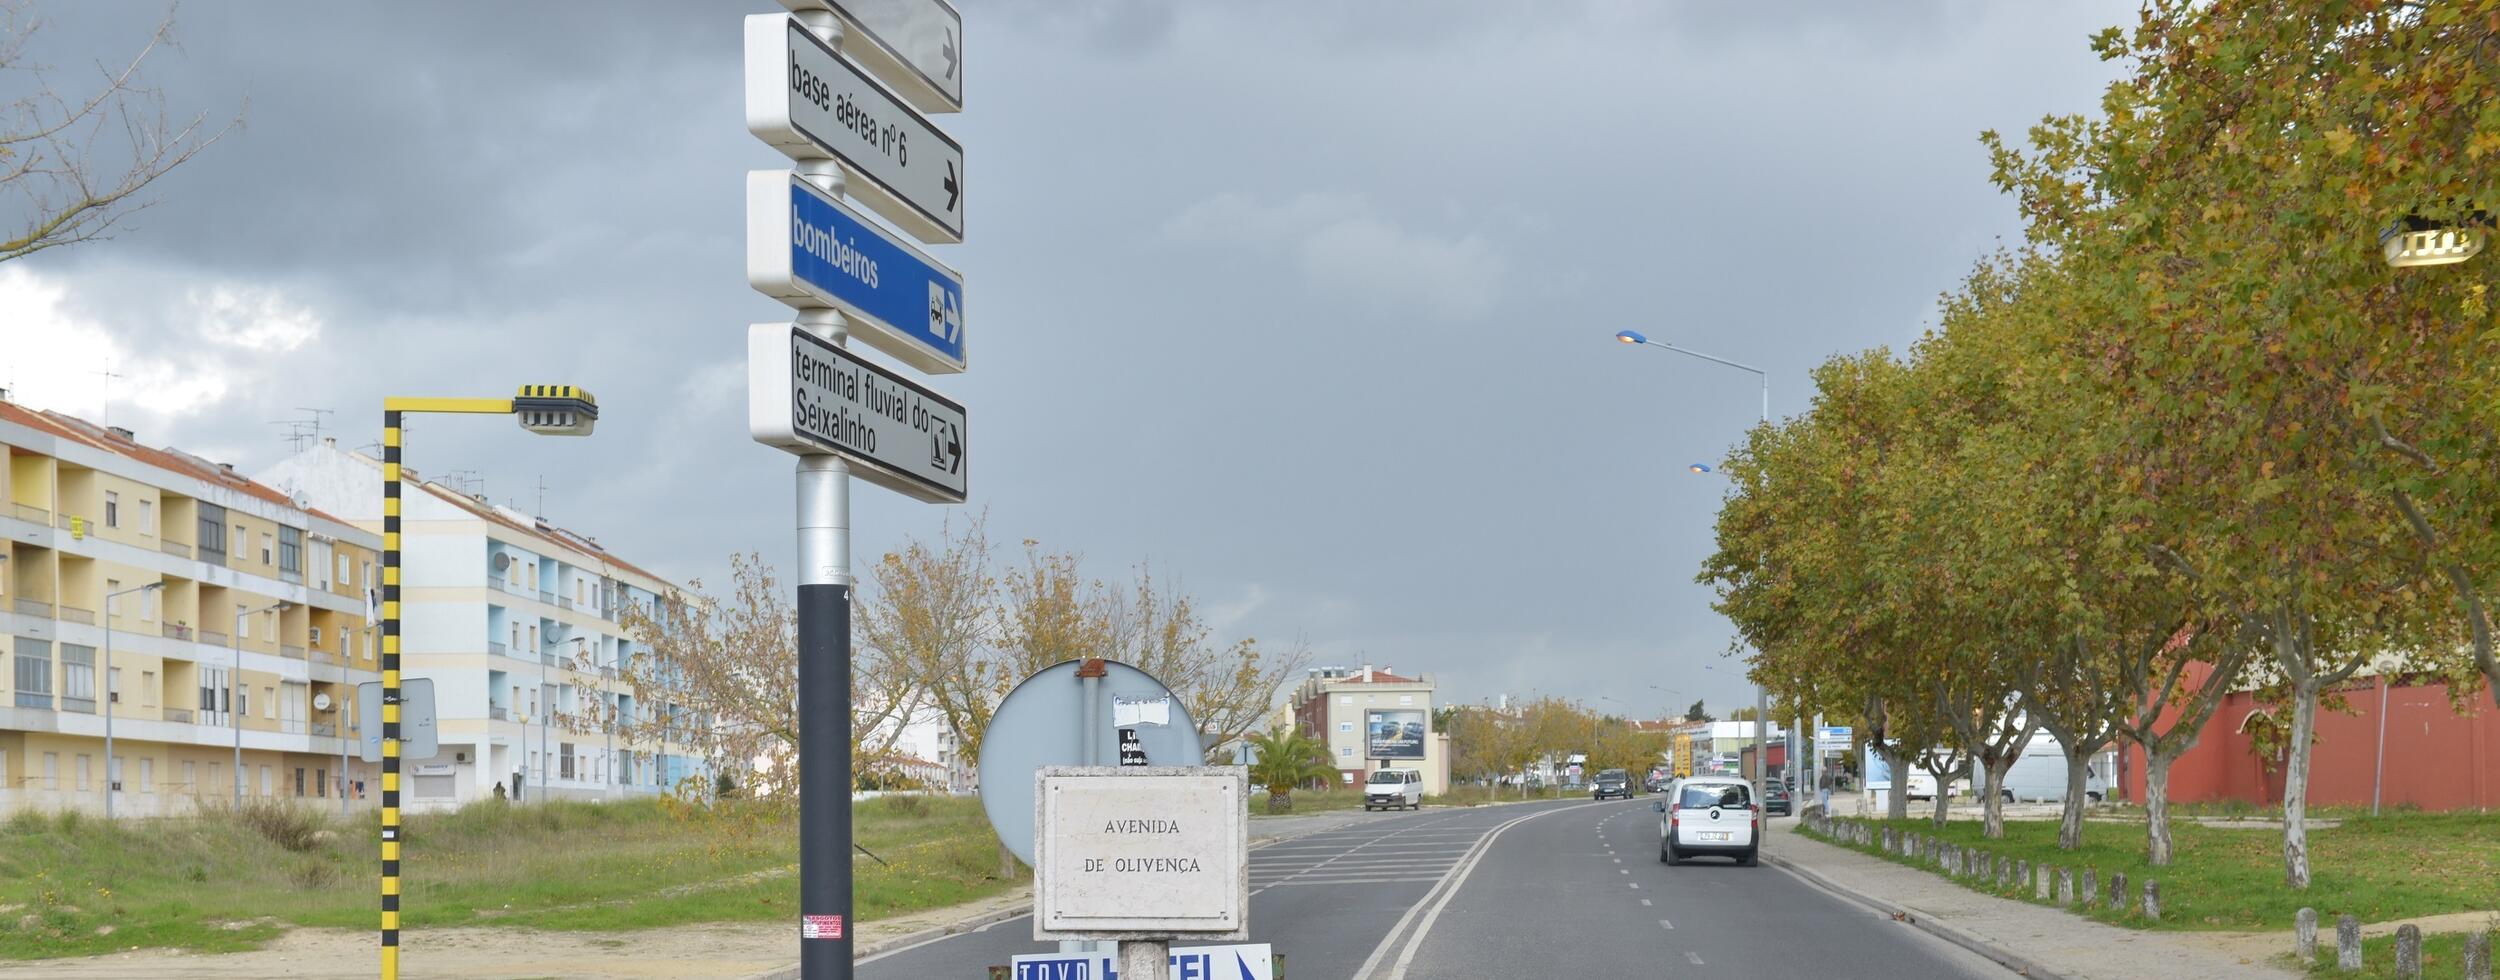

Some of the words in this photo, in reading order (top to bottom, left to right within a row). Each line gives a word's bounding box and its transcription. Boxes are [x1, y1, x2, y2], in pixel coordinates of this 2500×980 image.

[792, 49, 830, 112] base
[837, 93, 877, 147] aérea
[899, 131, 907, 168] 6
[793, 203, 879, 289] bombeiros
[795, 344, 859, 404] terminal
[864, 373, 907, 425] fluvial
[912, 396, 929, 433] do
[796, 387, 876, 454] Seixalinho
[1104, 819, 1180, 834] AVENIDA
[1084, 858, 1105, 872] DE
[1115, 858, 1201, 874] OLIVENÇA
